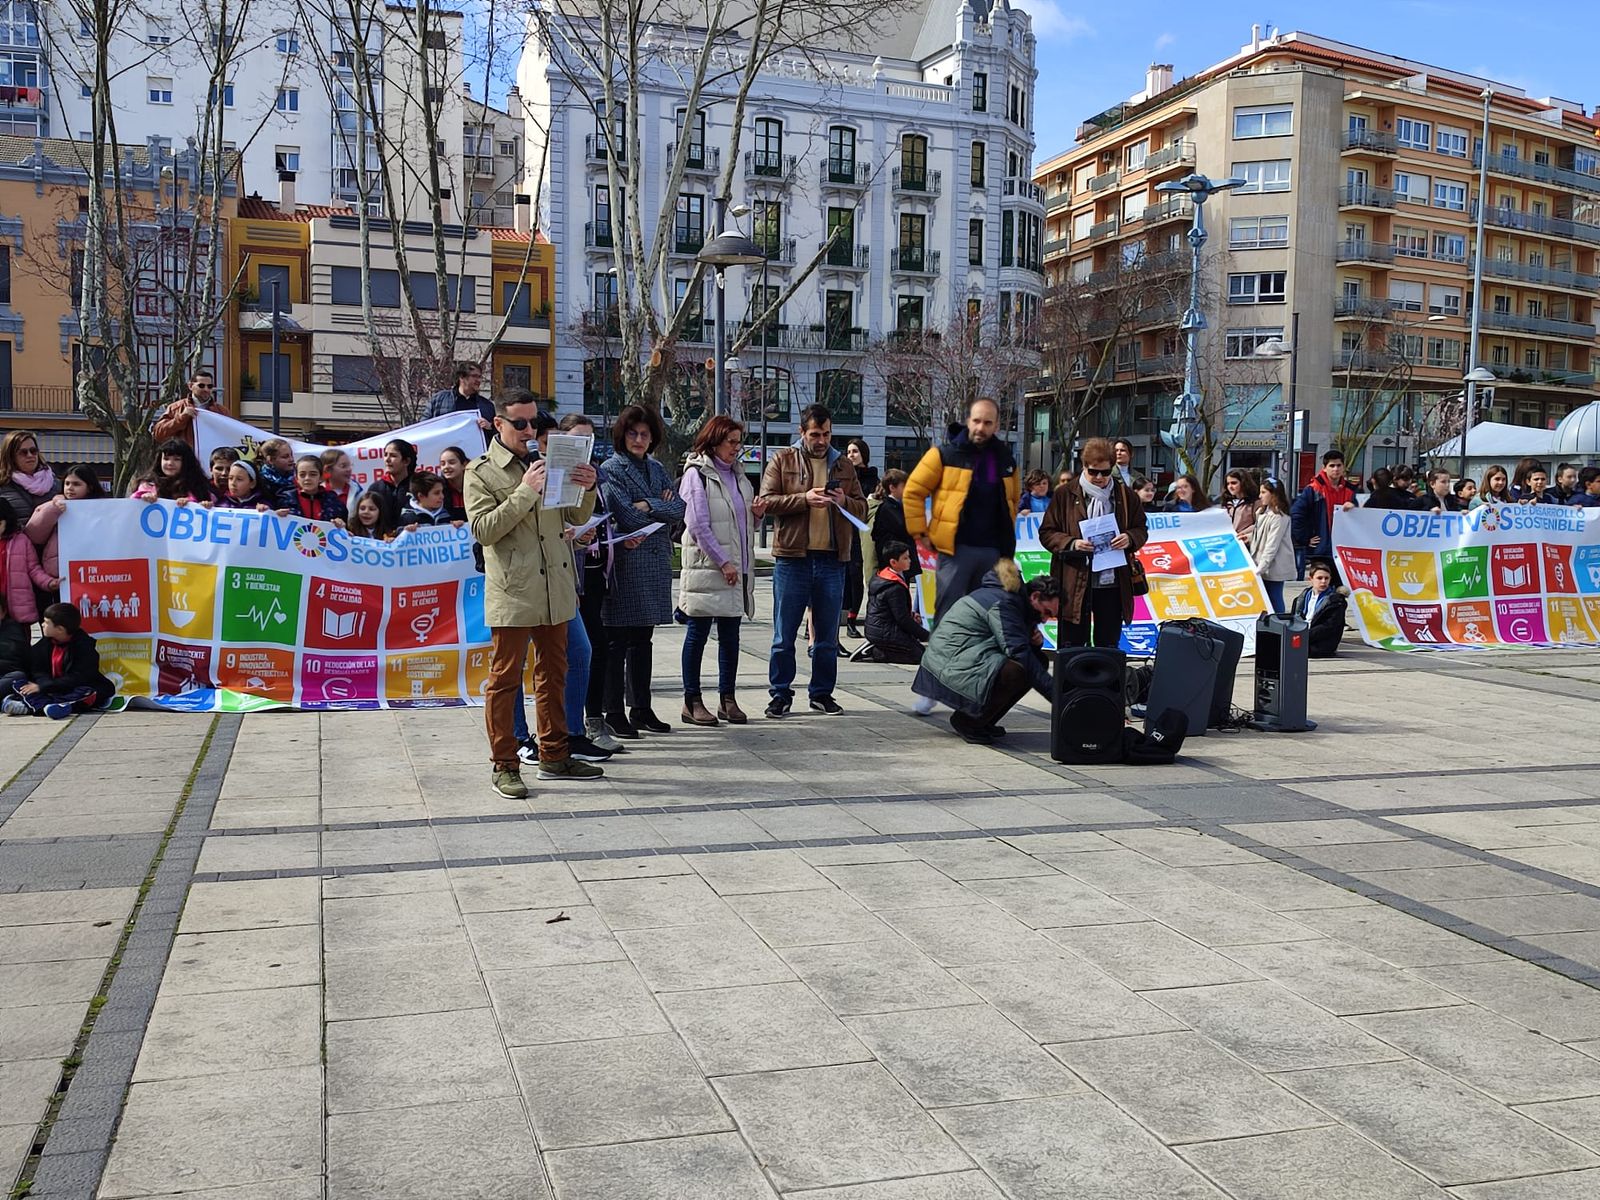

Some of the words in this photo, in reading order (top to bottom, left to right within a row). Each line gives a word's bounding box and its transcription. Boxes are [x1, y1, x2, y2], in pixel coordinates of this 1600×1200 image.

[1514, 516, 1586, 532] SOSTENIBLE
[351, 543, 470, 568] SOSTENIBLE
[1390, 554, 1397, 567] 2
[1446, 553, 1453, 564] 3
[1495, 548, 1501, 560] 4
[1580, 549, 1586, 560] 6
[78, 566, 85, 583] 1
[162, 565, 168, 581] 2
[231, 572, 240, 588] 3
[316, 583, 326, 598] 4
[469, 583, 477, 597] 6
[398, 593, 406, 608] 5
[1550, 600, 1559, 612] 11
[1397, 606, 1404, 617] 8
[1450, 606, 1457, 618] 9
[1497, 603, 1508, 615] 10
[160, 646, 166, 661] 8
[471, 652, 483, 668] 12
[226, 653, 235, 669] 9
[306, 659, 321, 673] 10
[391, 658, 402, 672] 11
